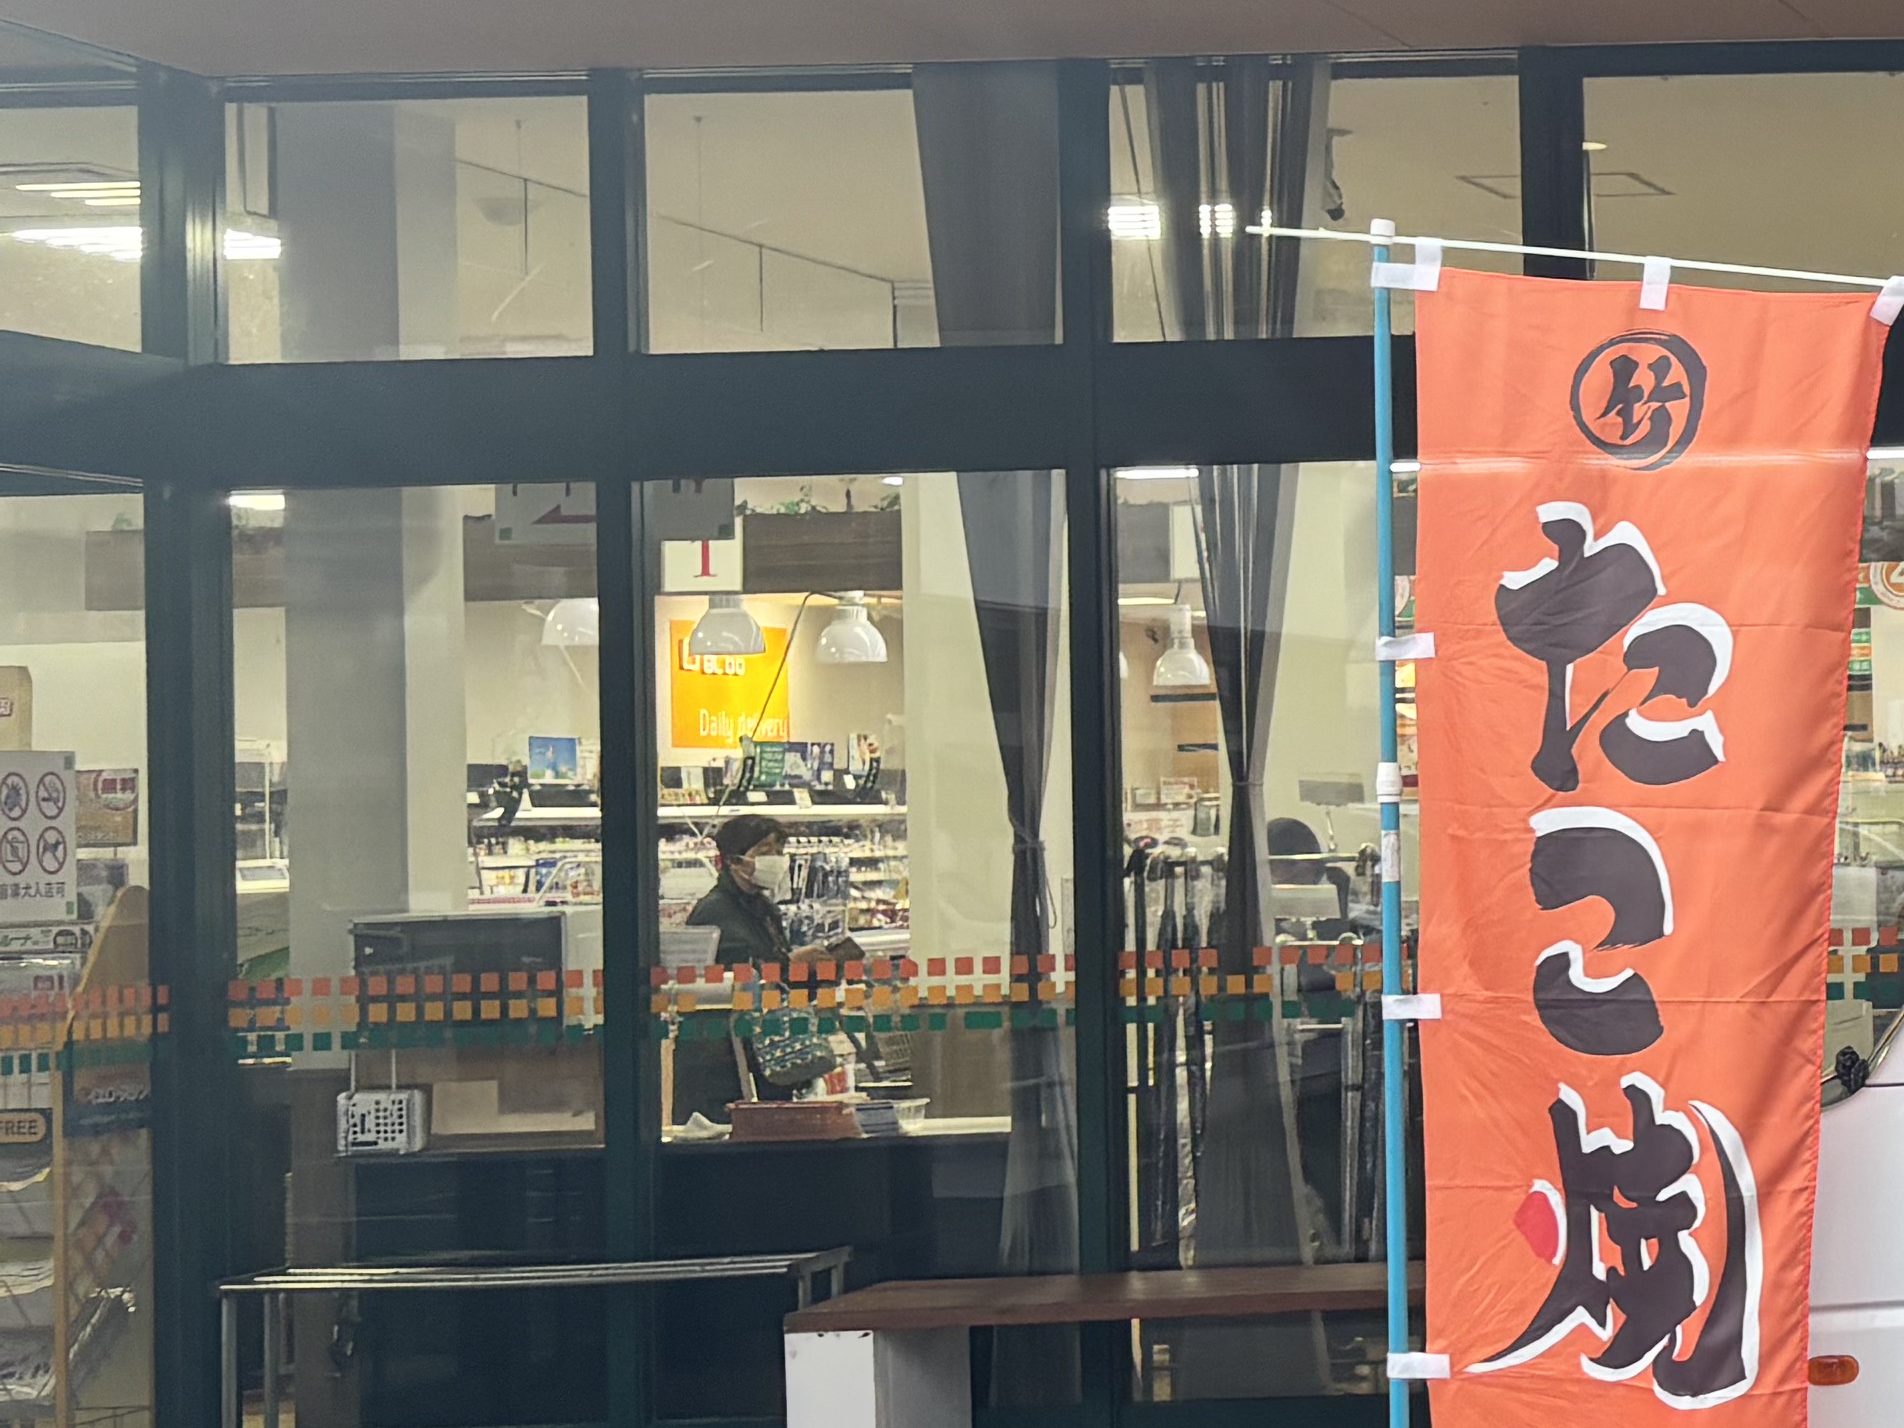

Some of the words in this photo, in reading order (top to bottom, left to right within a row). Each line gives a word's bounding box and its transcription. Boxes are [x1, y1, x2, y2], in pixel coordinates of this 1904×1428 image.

[1594, 352, 1692, 450] 竹
[1466, 500, 1764, 1412] たこ焼
